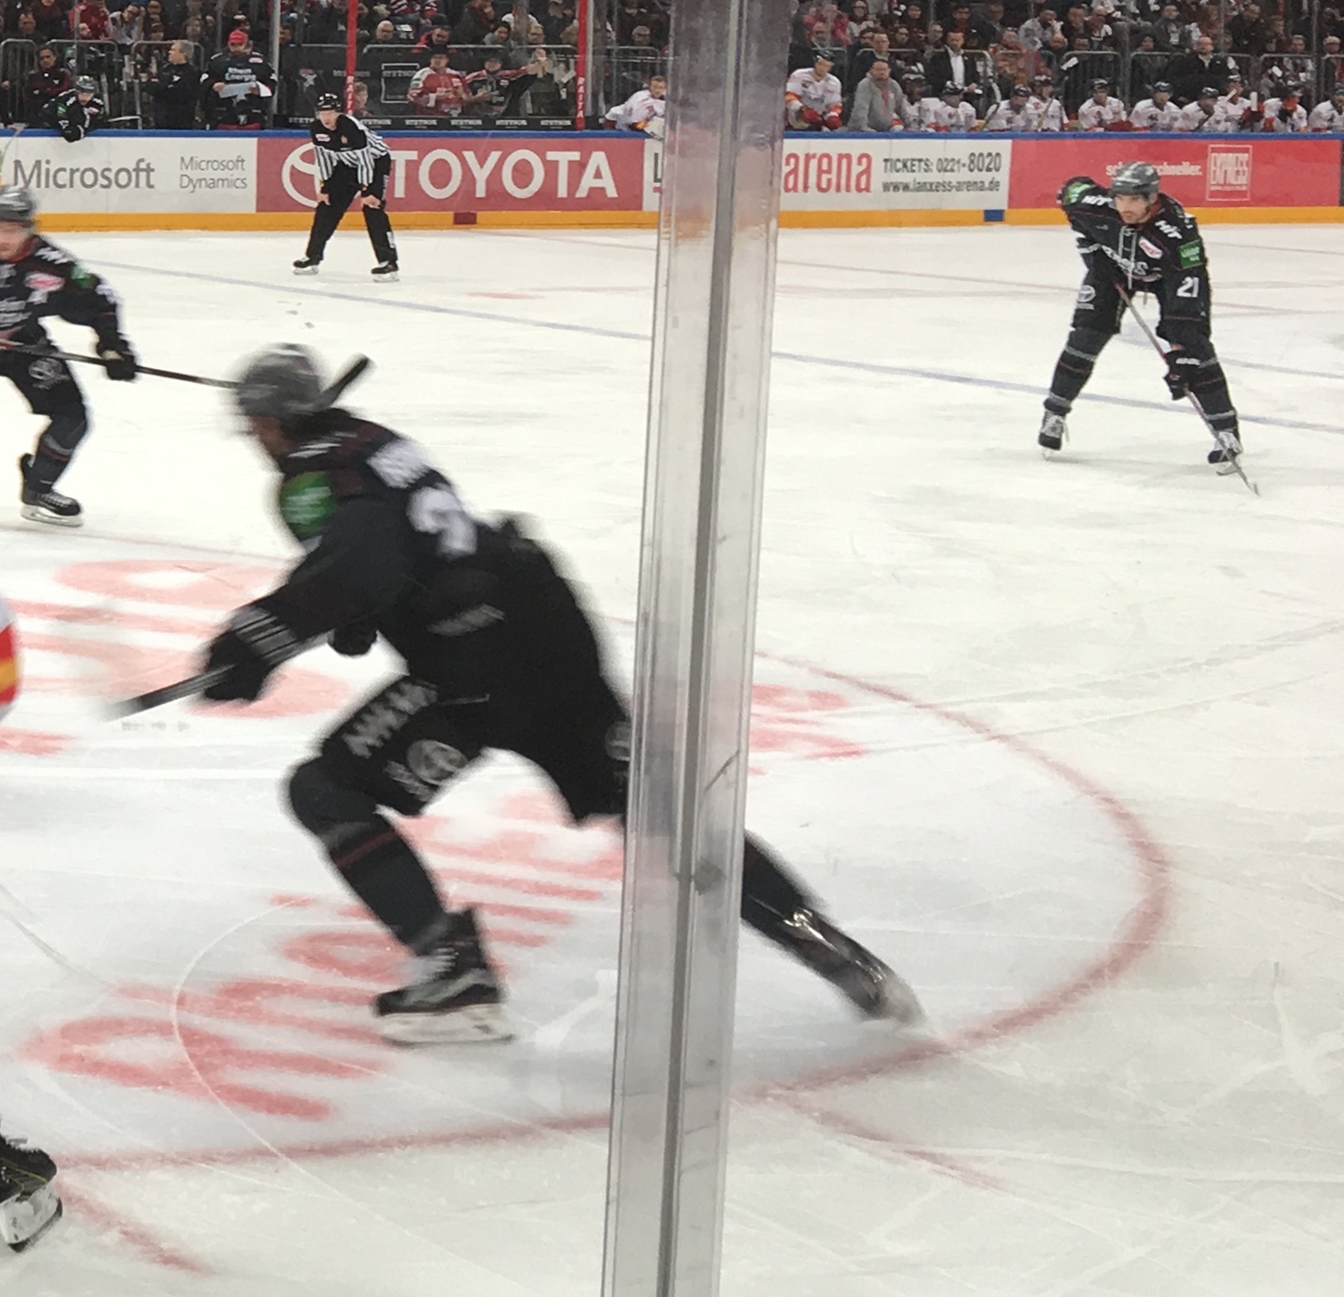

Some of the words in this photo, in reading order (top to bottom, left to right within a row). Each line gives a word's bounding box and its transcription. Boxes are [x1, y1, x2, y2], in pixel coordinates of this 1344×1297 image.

[178, 155, 247, 172] Microsoft
[782, 151, 875, 194] arena
[882, 157, 934, 174] TICKETS:
[936, 151, 1002, 174] 0221-8020
[13, 158, 156, 190] Microsoft
[178, 175, 249, 194] Dynamics
[390, 148, 620, 201] TOYOTA
[881, 177, 1002, 193] www.lanxess-arena.de
[1176, 276, 1200, 298] 21
